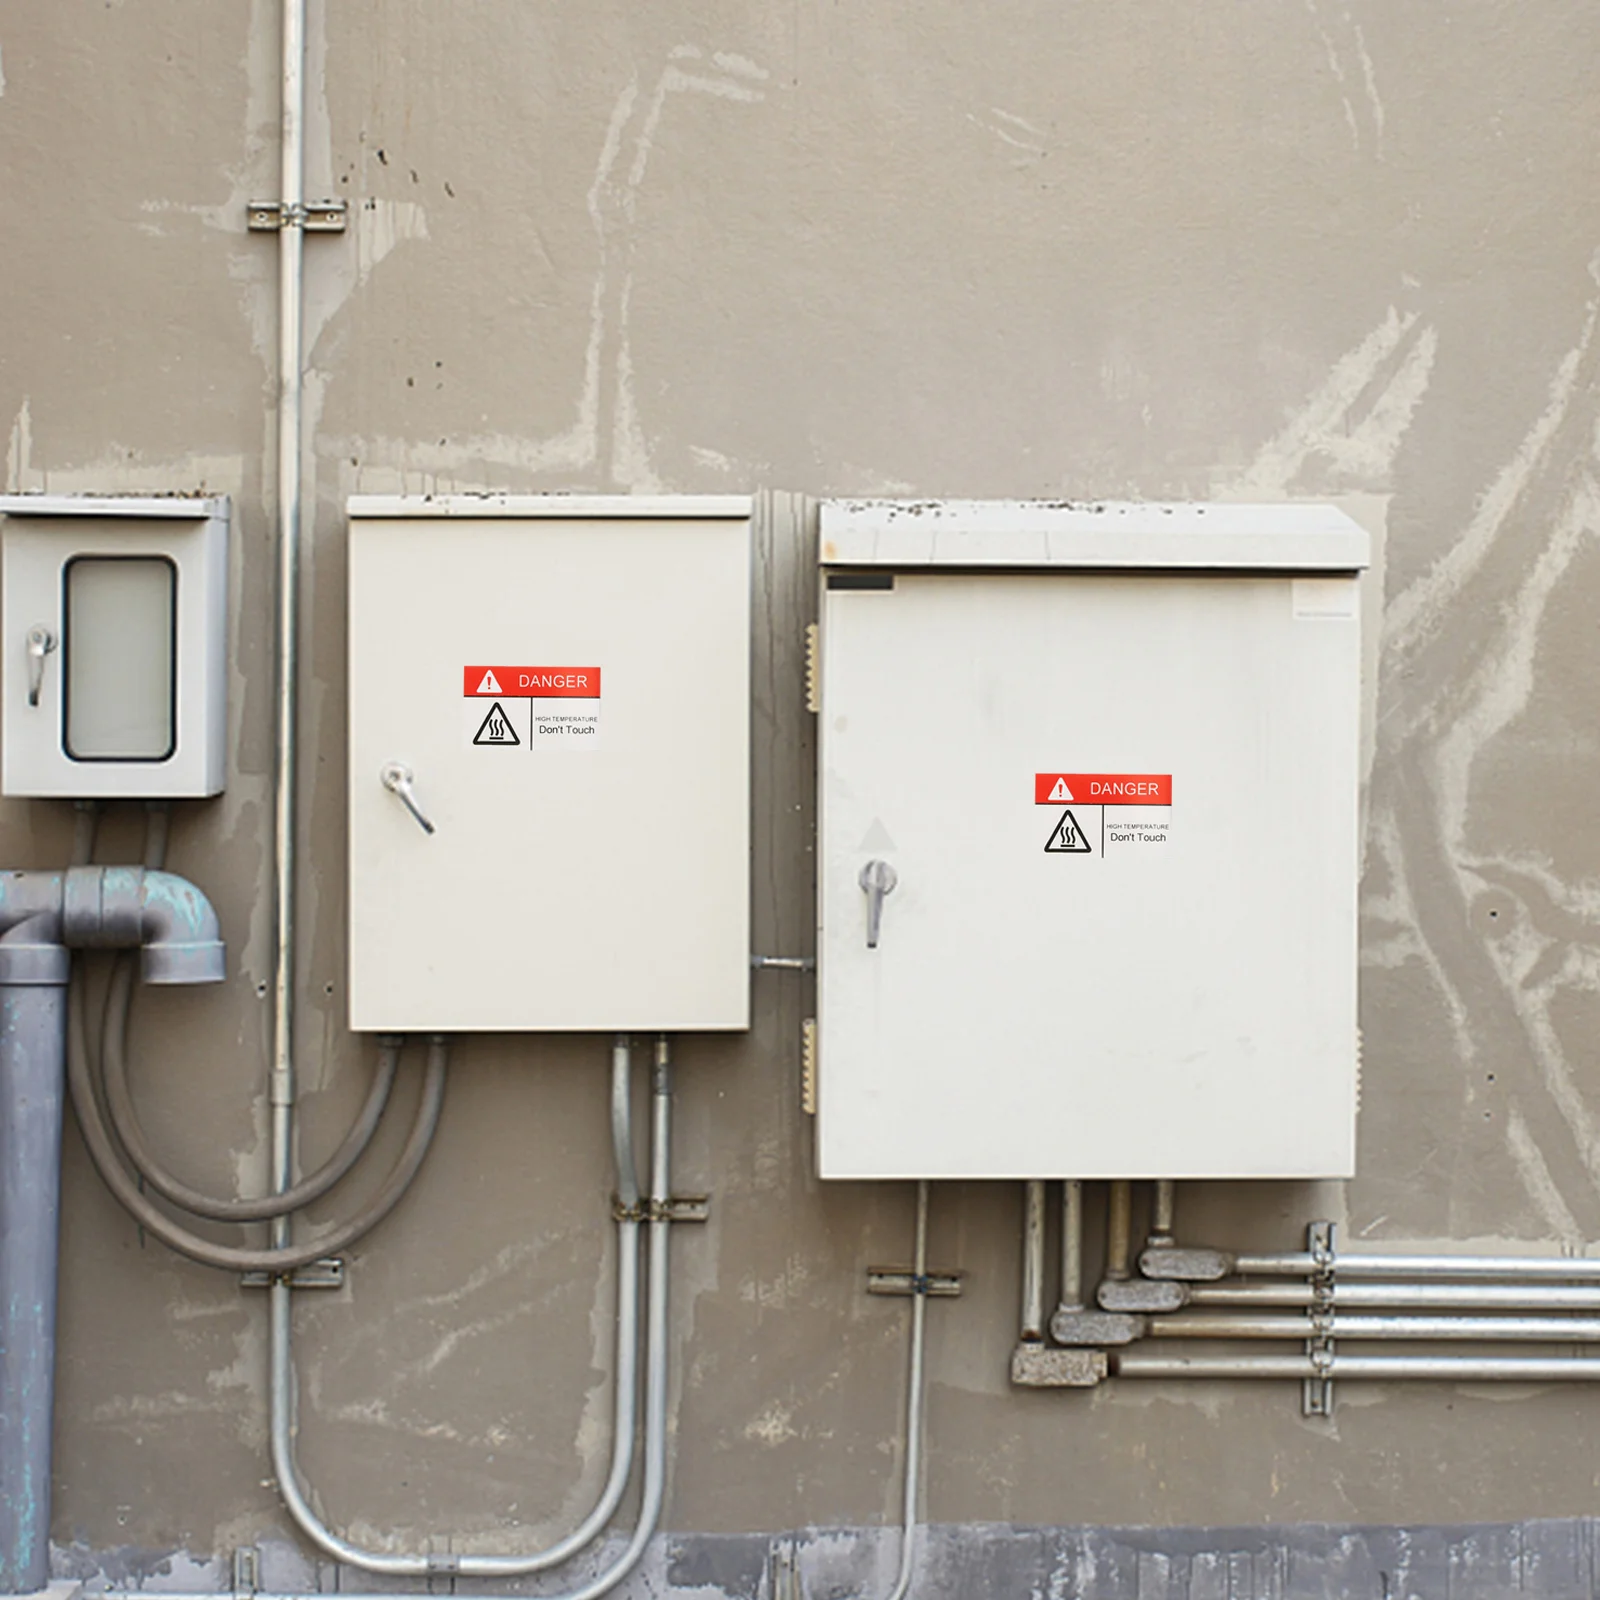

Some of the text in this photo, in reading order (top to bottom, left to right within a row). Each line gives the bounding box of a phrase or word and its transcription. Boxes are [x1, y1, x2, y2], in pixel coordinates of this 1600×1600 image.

[519, 674, 588, 689] DANGER
[539, 725, 595, 735] Don't Touch
[1090, 781, 1159, 796] DANGER
[1110, 833, 1166, 842] Don't Touch
